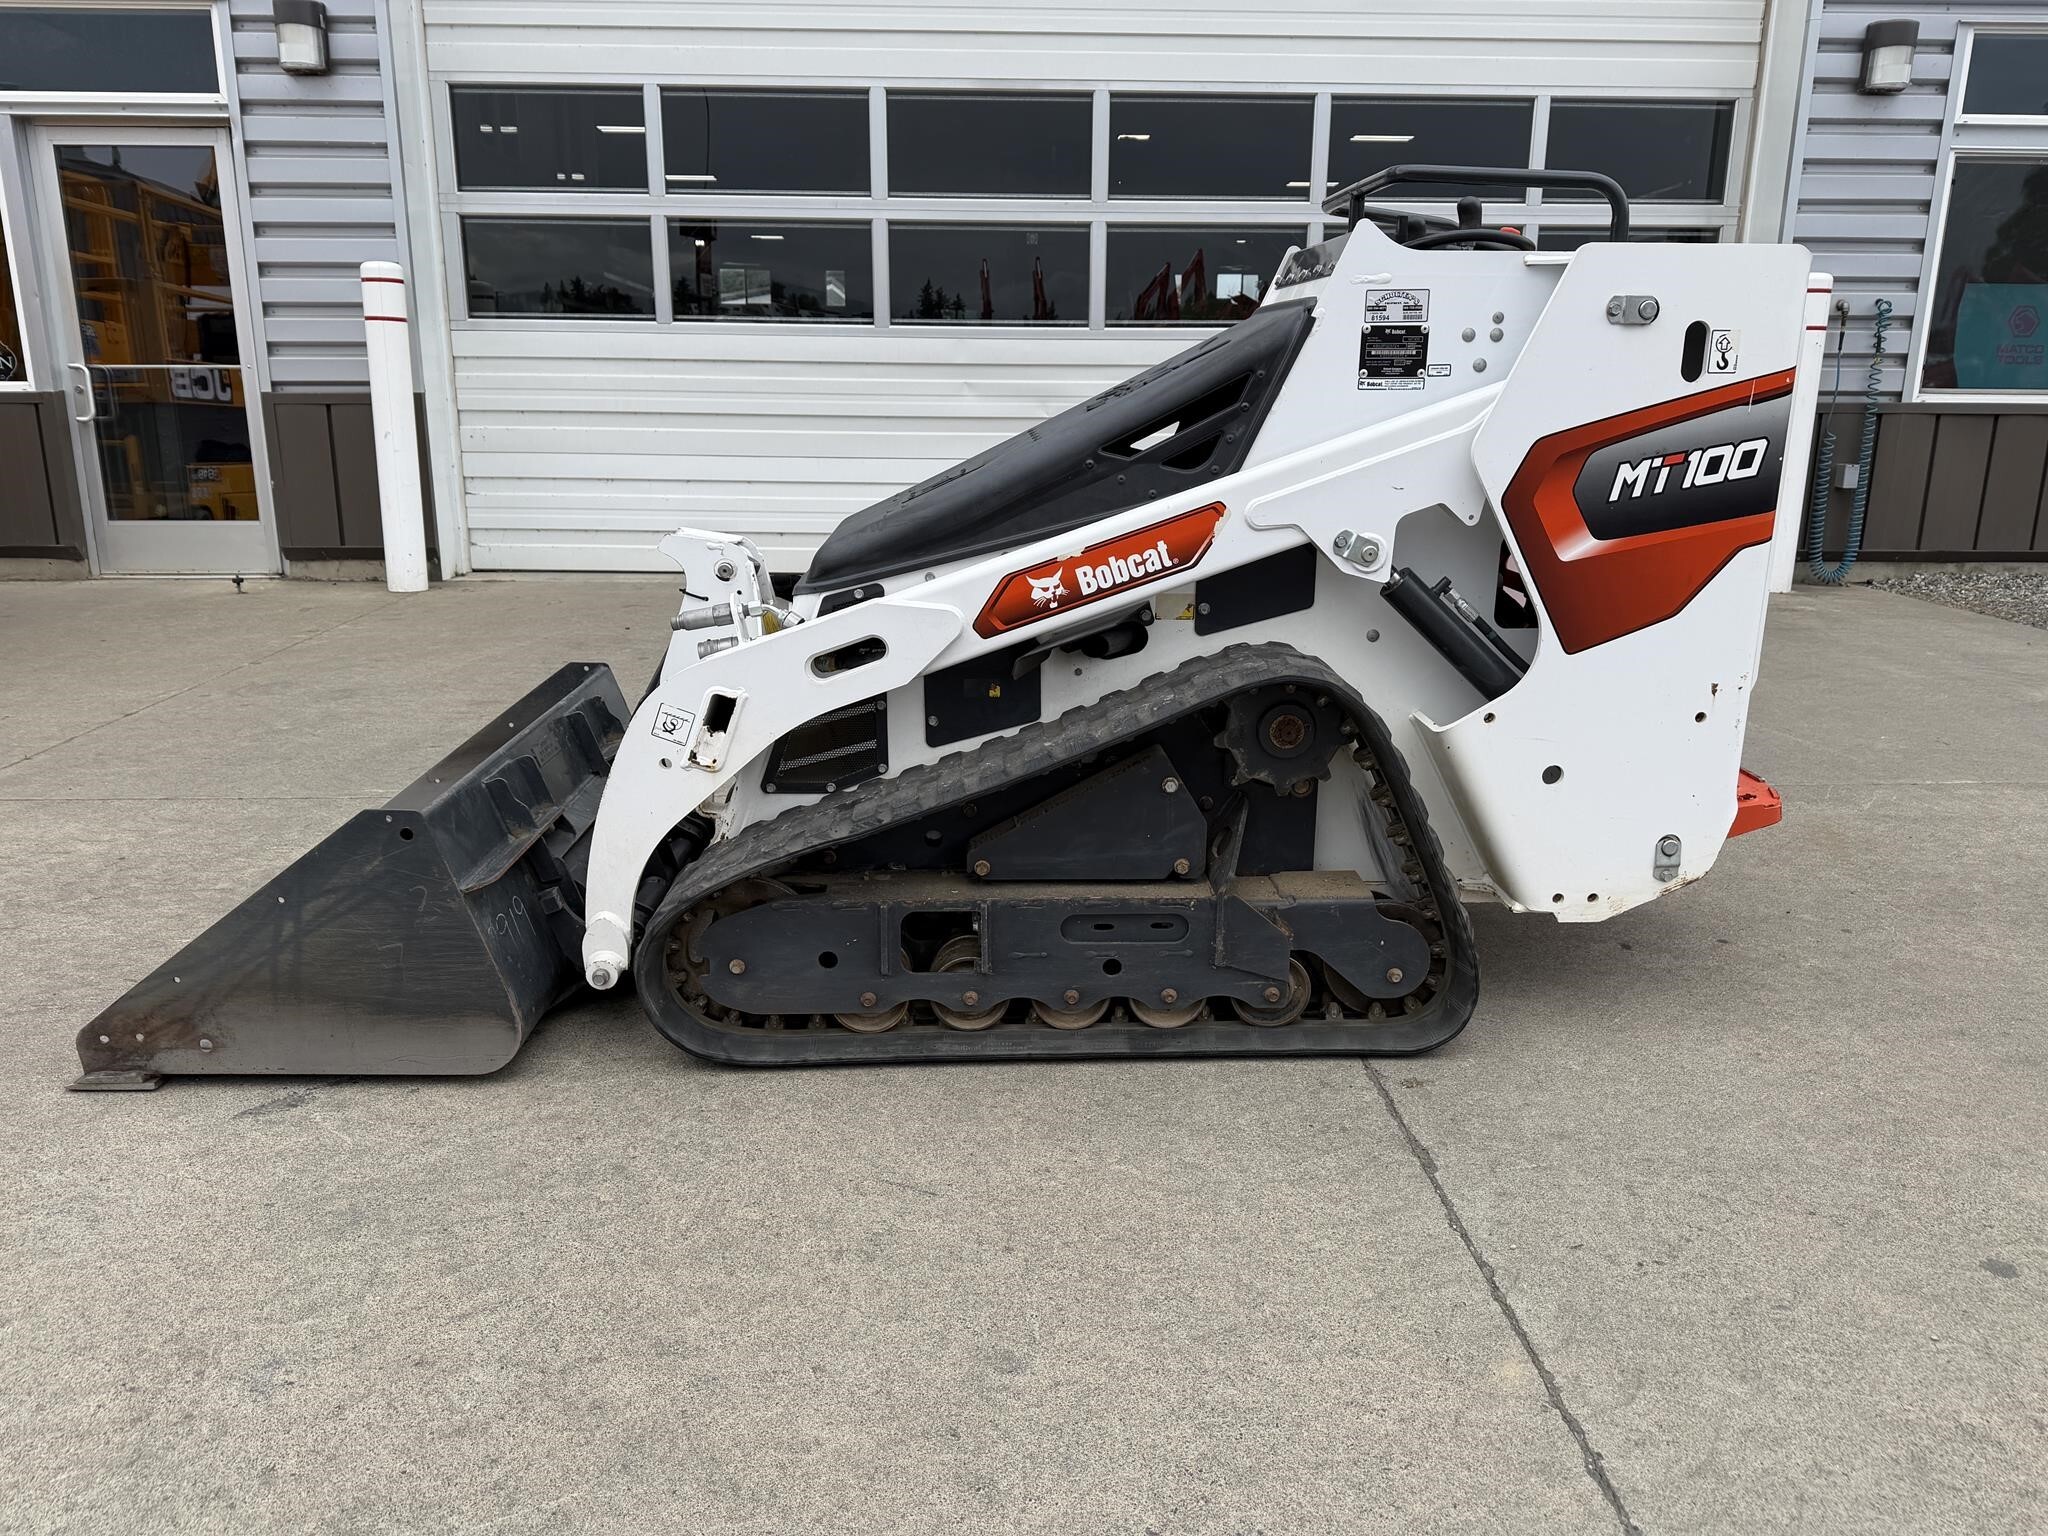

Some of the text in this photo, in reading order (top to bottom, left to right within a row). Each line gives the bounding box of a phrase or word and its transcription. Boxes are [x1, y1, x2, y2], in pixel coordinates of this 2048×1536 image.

[1996, 344, 2045, 354] MATCO
[1997, 355, 2043, 365] TOOLS
[1608, 438, 1769, 502] MT100
[1074, 540, 1173, 596] Bobcat
